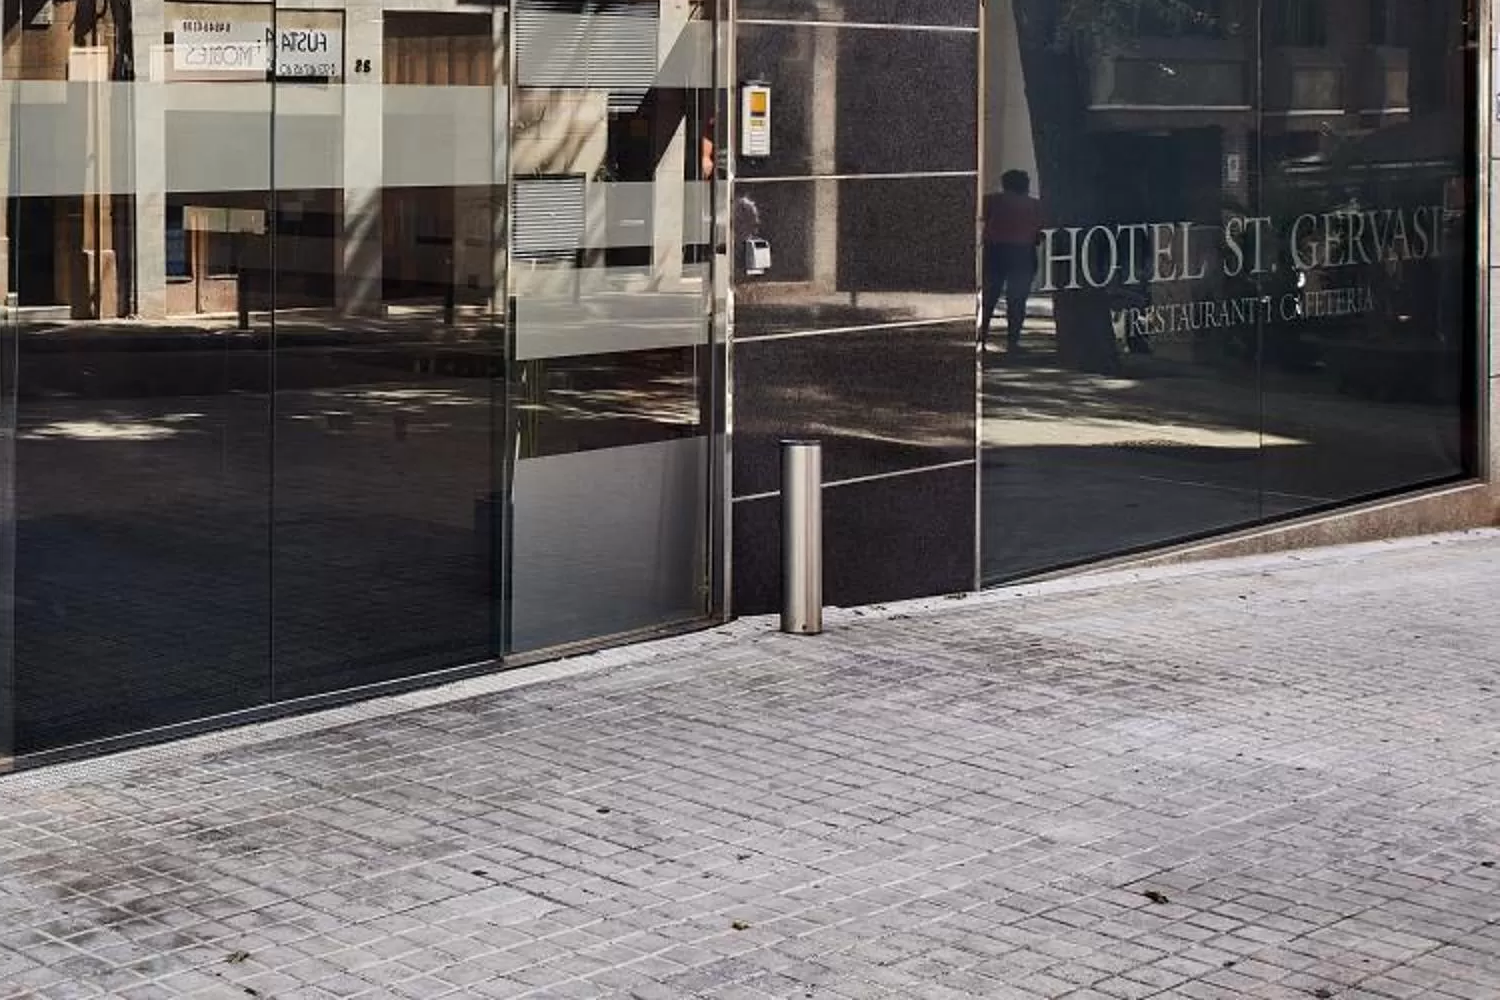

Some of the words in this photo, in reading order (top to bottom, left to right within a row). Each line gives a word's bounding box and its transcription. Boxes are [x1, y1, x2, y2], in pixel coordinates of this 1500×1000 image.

[1038, 221, 1207, 292] HOTEL
[1223, 215, 1278, 276] ST.
[1290, 204, 1443, 270] GERVASI
[1129, 297, 1259, 336] RESTAURANT
